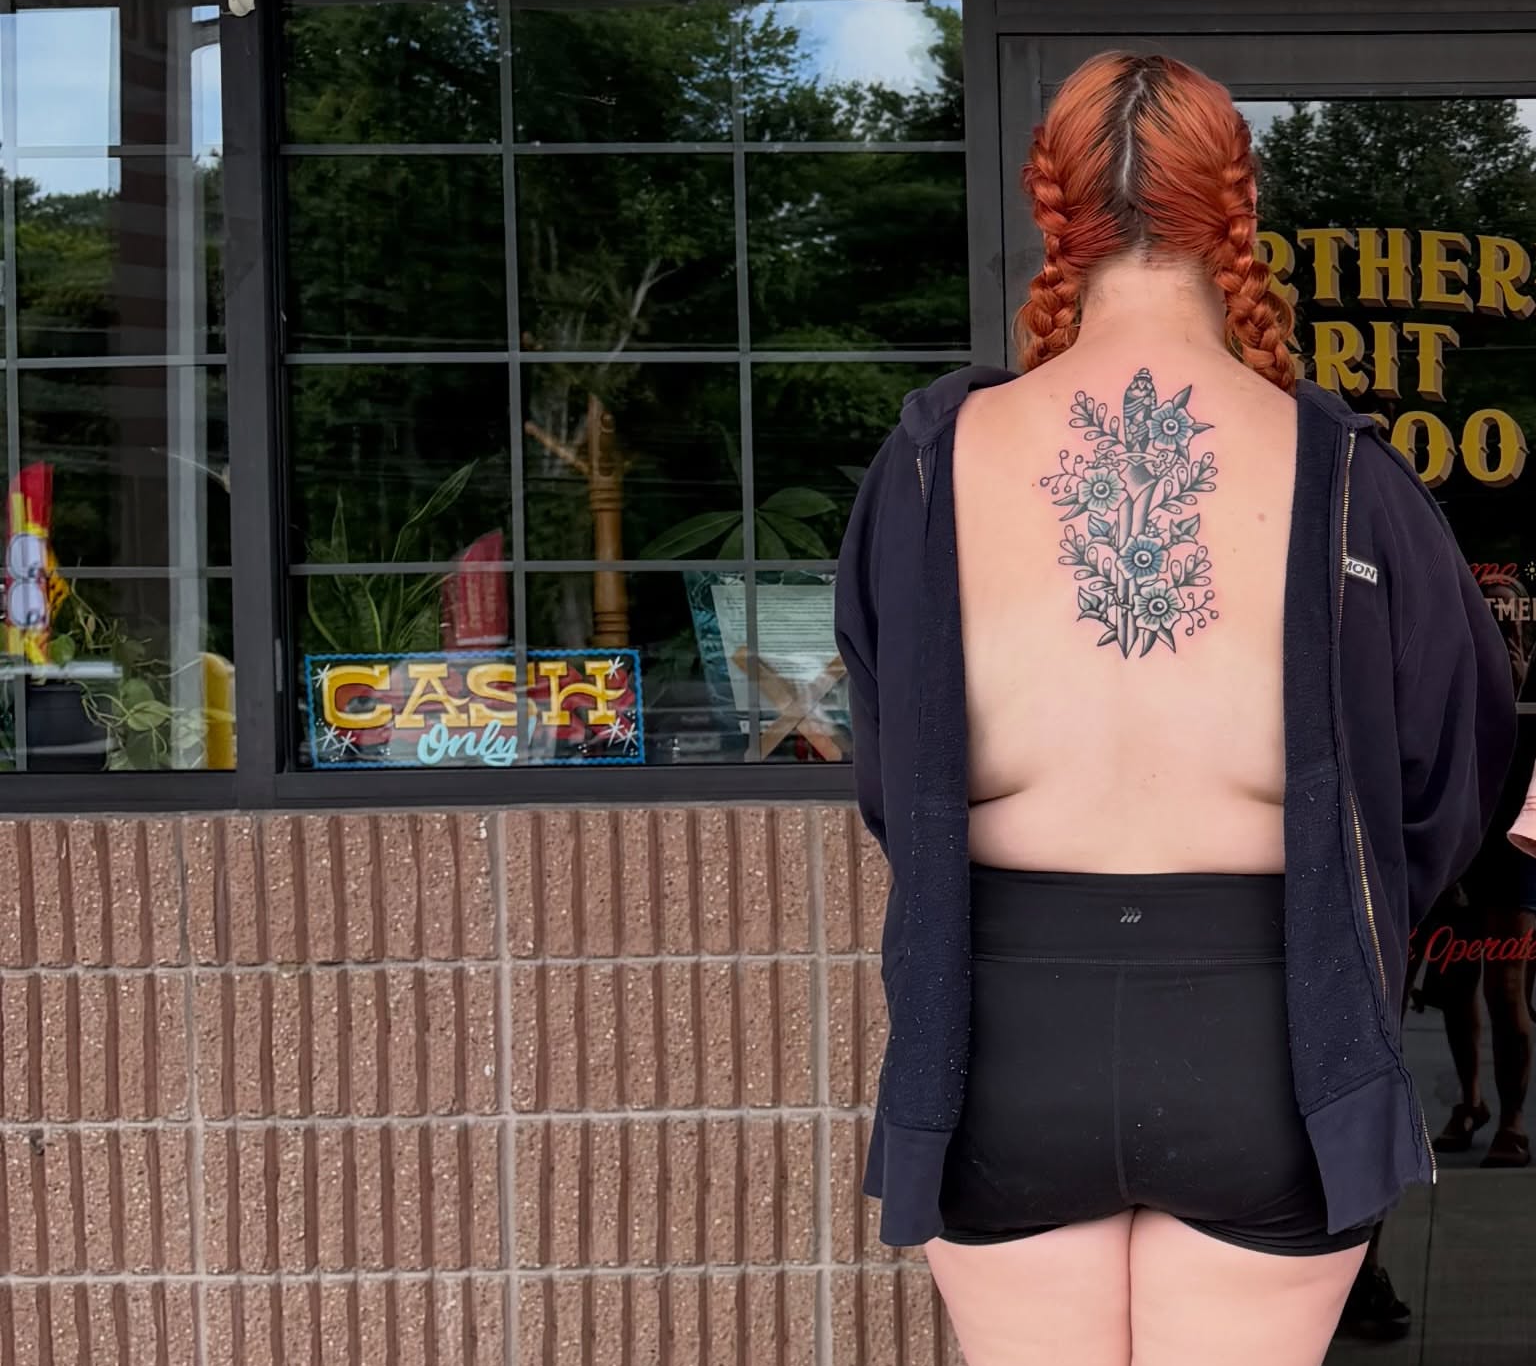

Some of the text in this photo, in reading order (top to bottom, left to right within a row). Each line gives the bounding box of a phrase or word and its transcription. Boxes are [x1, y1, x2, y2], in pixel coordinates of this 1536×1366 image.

[1292, 321, 1460, 403] RIT
[1370, 408, 1530, 489] OO
[321, 660, 627, 730] CASH
